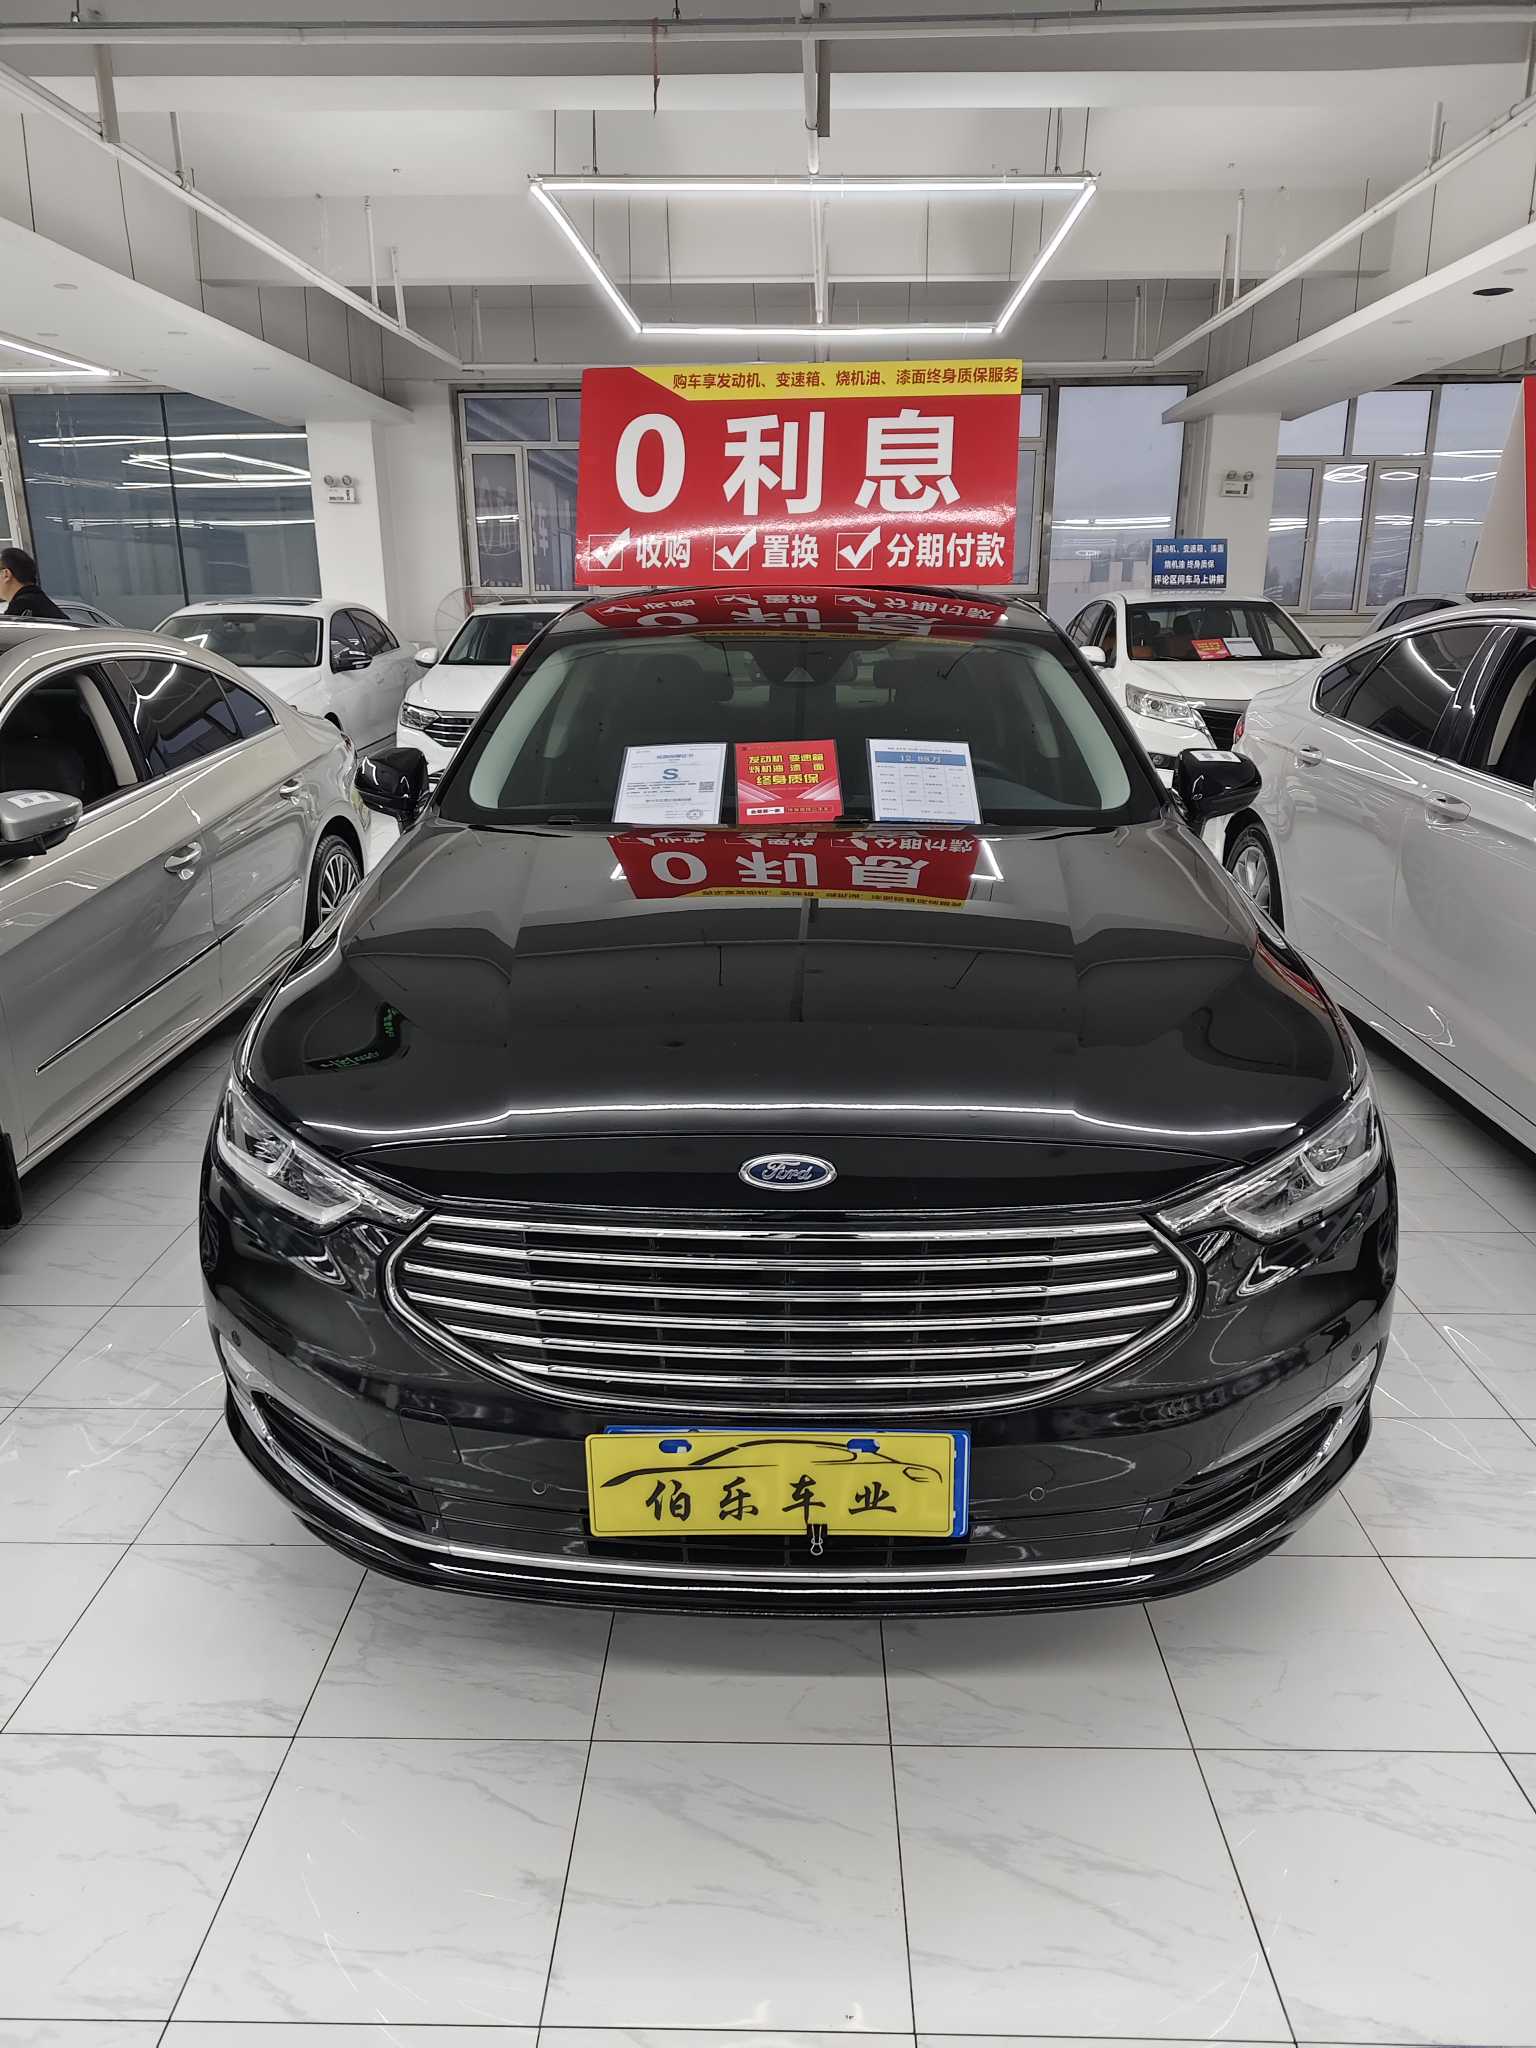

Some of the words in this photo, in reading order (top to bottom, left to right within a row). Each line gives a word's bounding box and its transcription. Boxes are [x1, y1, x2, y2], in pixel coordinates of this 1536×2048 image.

[672, 367, 1019, 390] 购车享发动机、变速箱、烧机油、漆面终身质保服务
[635, 532, 691, 568] 收购
[762, 533, 819, 568] 置换
[886, 532, 1006, 568] 分期付款
[662, 768, 679, 780] S
[756, 773, 819, 785] 终身质保
[762, 1161, 813, 1180] Ford
[645, 1474, 897, 1523] 伯乐车业
